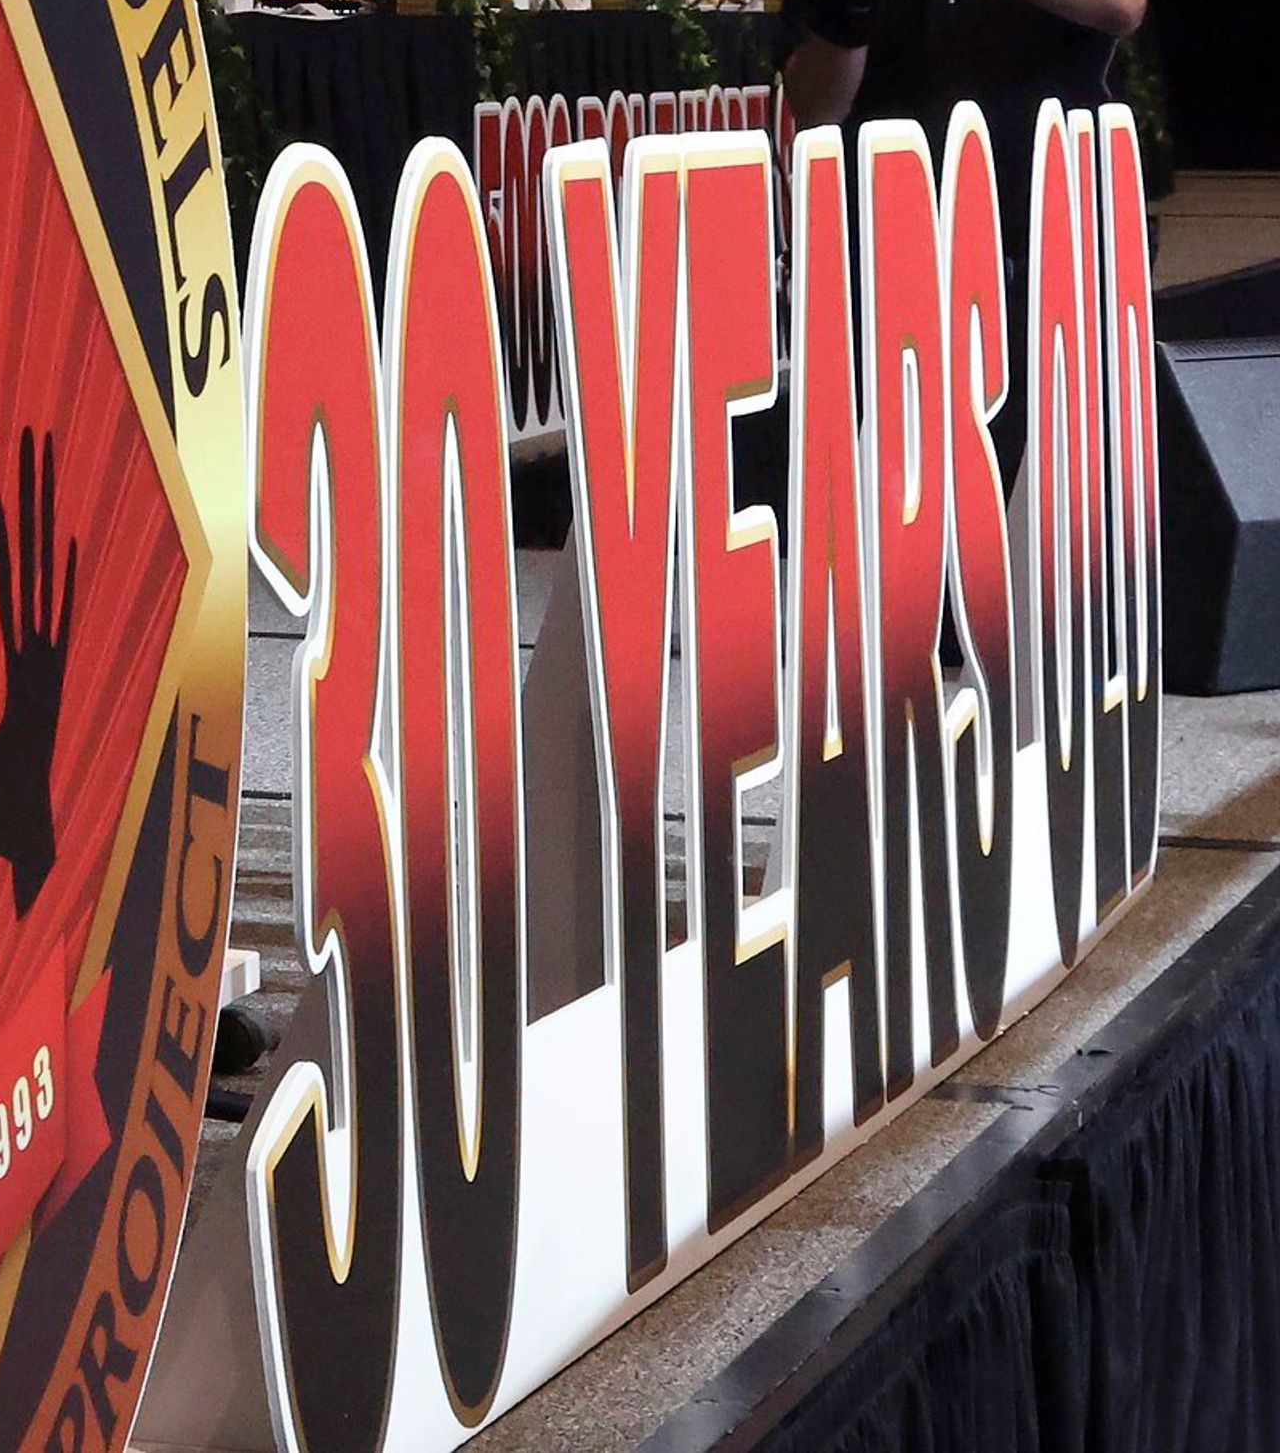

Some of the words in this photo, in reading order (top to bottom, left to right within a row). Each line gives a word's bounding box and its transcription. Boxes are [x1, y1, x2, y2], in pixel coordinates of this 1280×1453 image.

[44, 713, 235, 1453] PROJECT
[544, 103, 1012, 1297] YEARS
[1032, 97, 1158, 969] OLD
